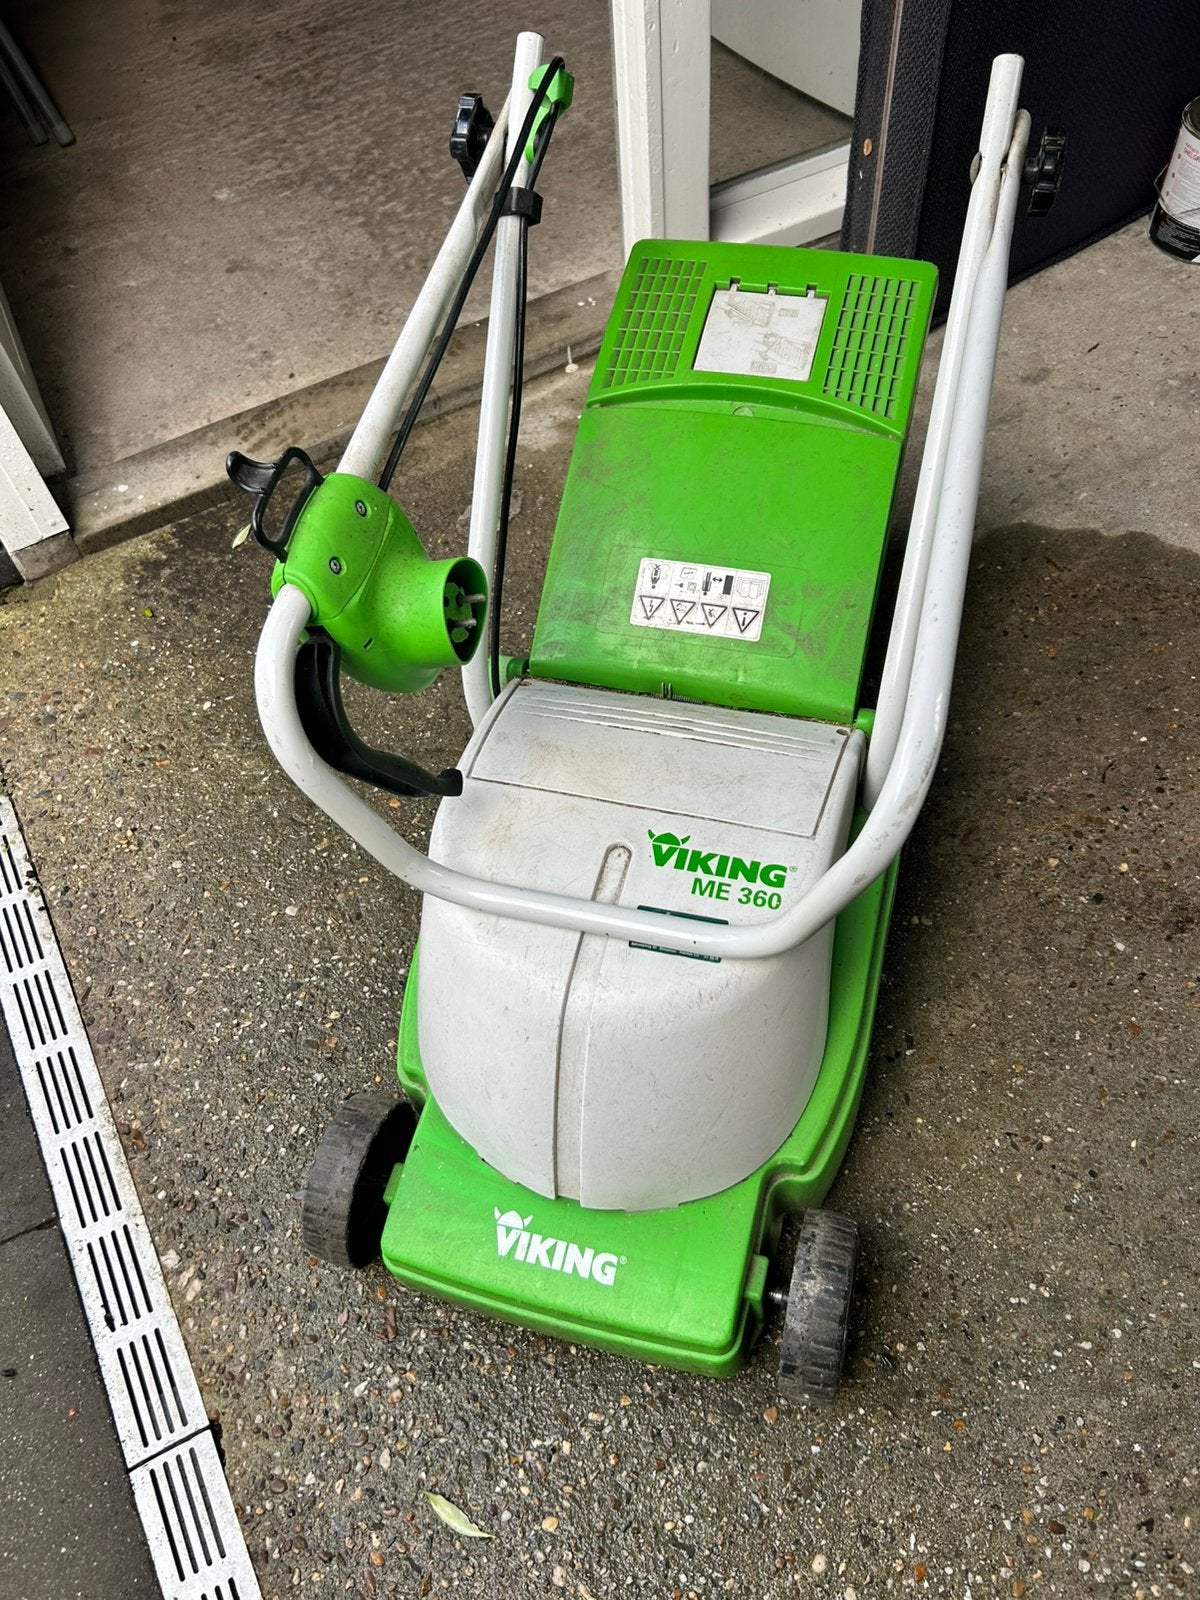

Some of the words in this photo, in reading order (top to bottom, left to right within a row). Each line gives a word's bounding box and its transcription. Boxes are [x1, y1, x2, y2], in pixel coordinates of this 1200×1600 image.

[652, 843, 788, 888] VIKING
[691, 877, 731, 901] ME
[738, 887, 782, 910] 360
[496, 1224, 618, 1286] VIKING
